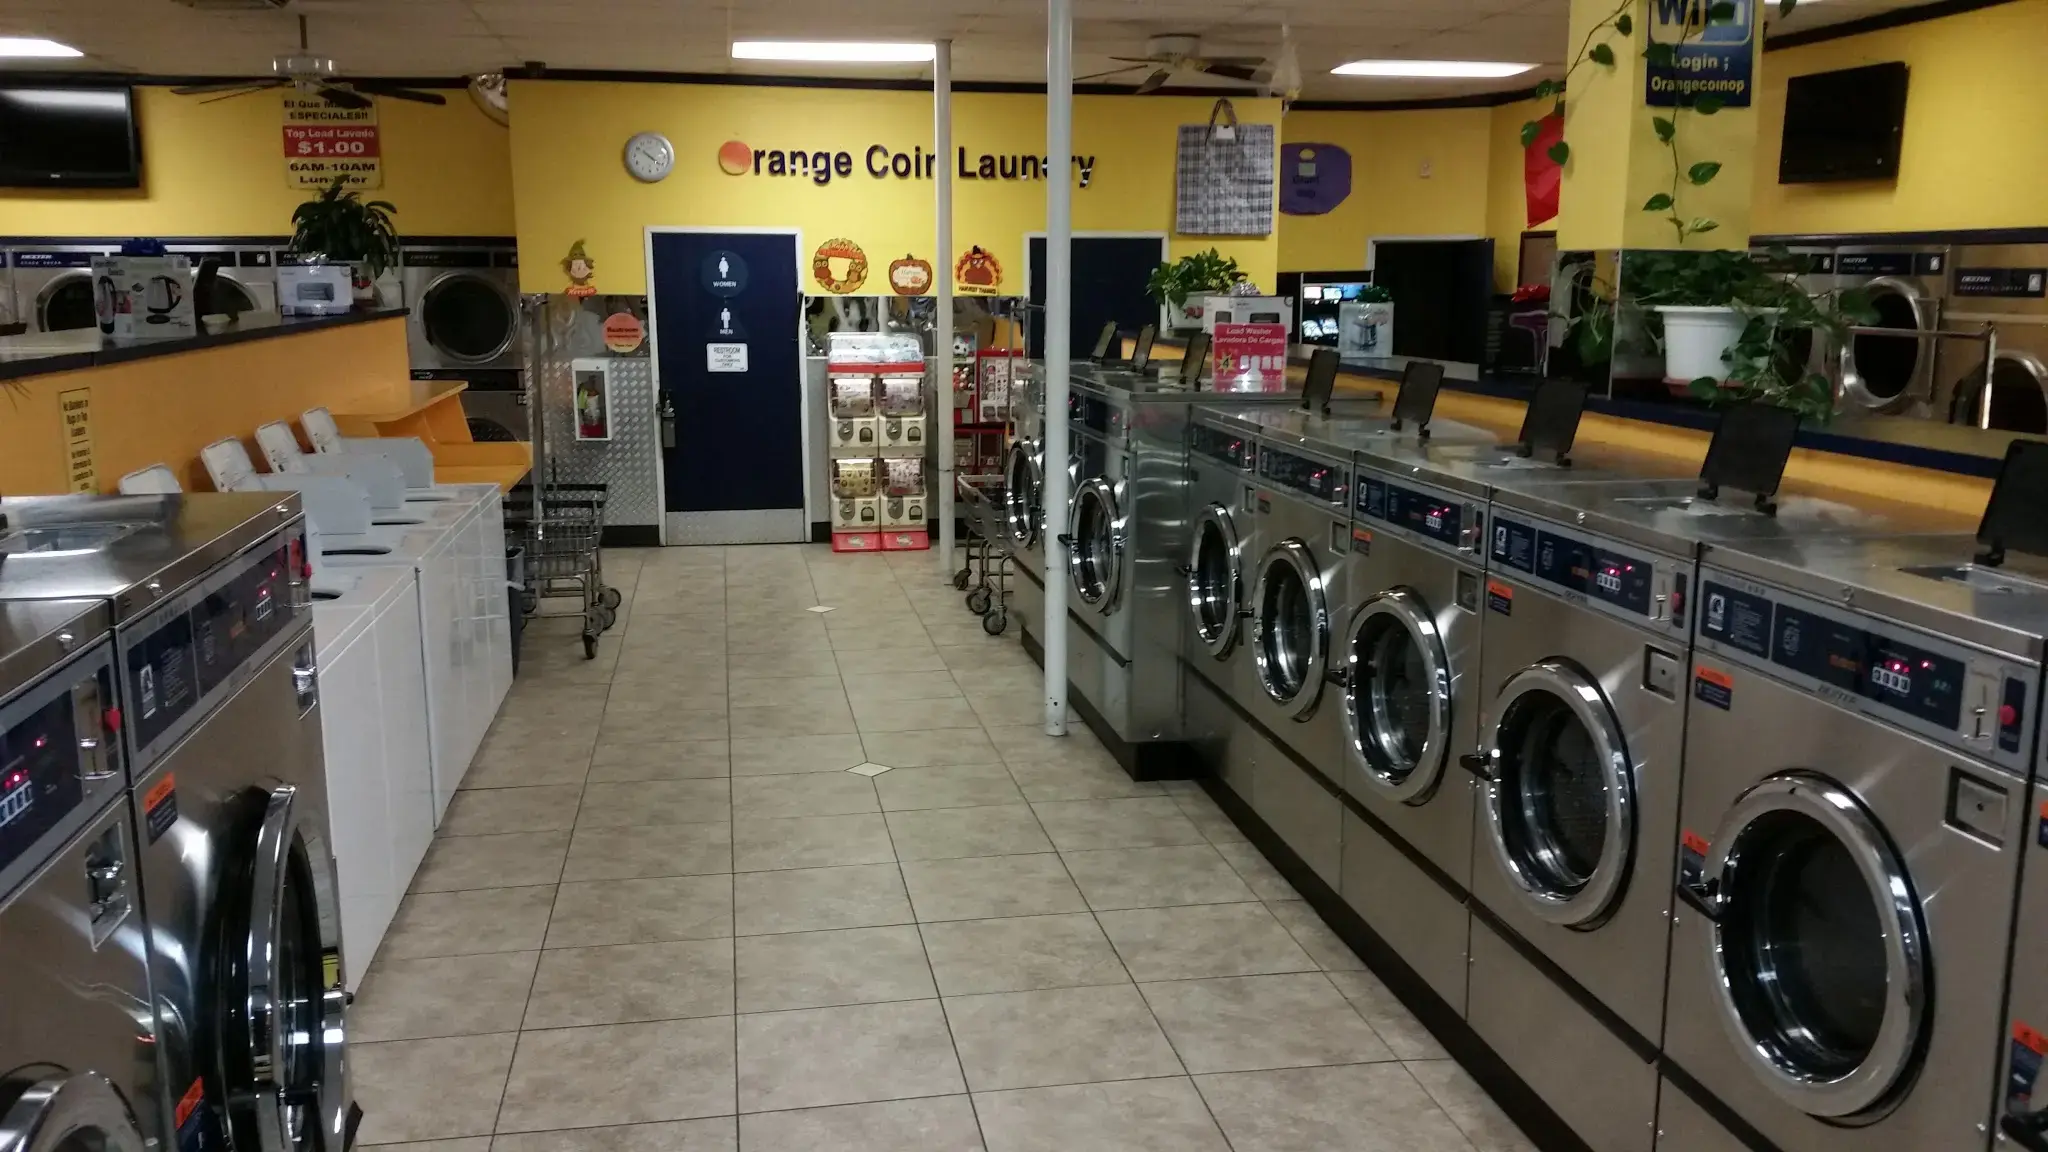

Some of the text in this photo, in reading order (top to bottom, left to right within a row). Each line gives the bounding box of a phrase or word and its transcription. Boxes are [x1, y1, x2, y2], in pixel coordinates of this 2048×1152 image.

[1671, 53, 1718, 72] Login
[286, 129, 306, 139] Top
[308, 129, 334, 138] Load
[297, 140, 365, 155] $1.00
[289, 162, 376, 172] 6AM-10AM
[712, 280, 737, 288] WOMEN
[719, 328, 734, 336] MEN
